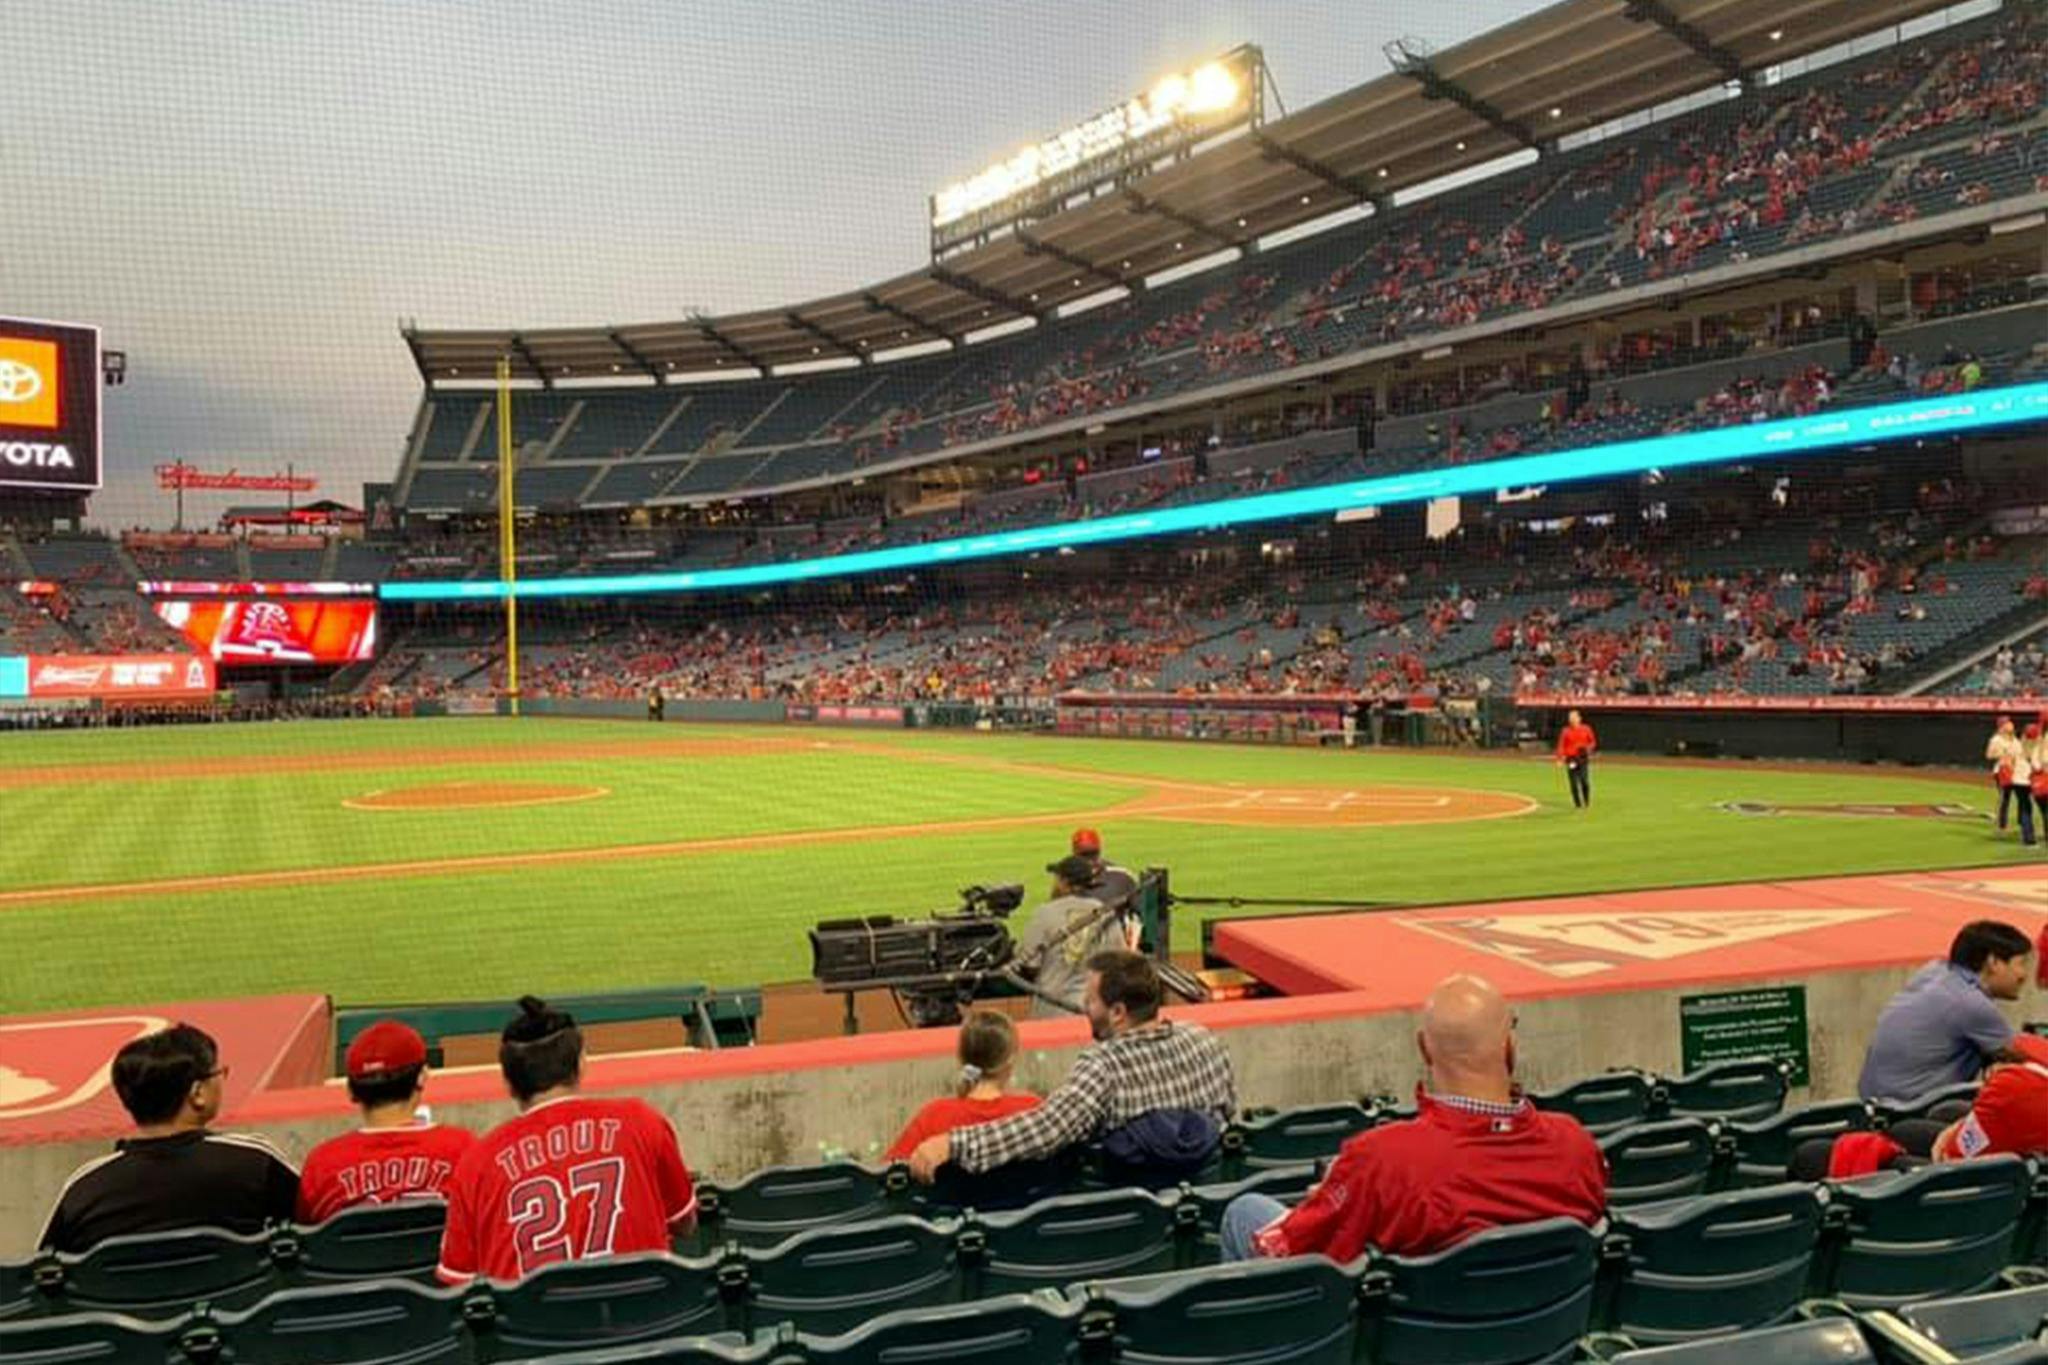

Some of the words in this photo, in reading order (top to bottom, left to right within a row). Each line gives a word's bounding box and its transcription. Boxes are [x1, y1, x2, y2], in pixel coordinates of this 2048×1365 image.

[1538, 916, 1728, 945] 79
[495, 1119, 621, 1181] TROUT
[338, 1156, 452, 1200] TROUT
[507, 1157, 625, 1278] 27
